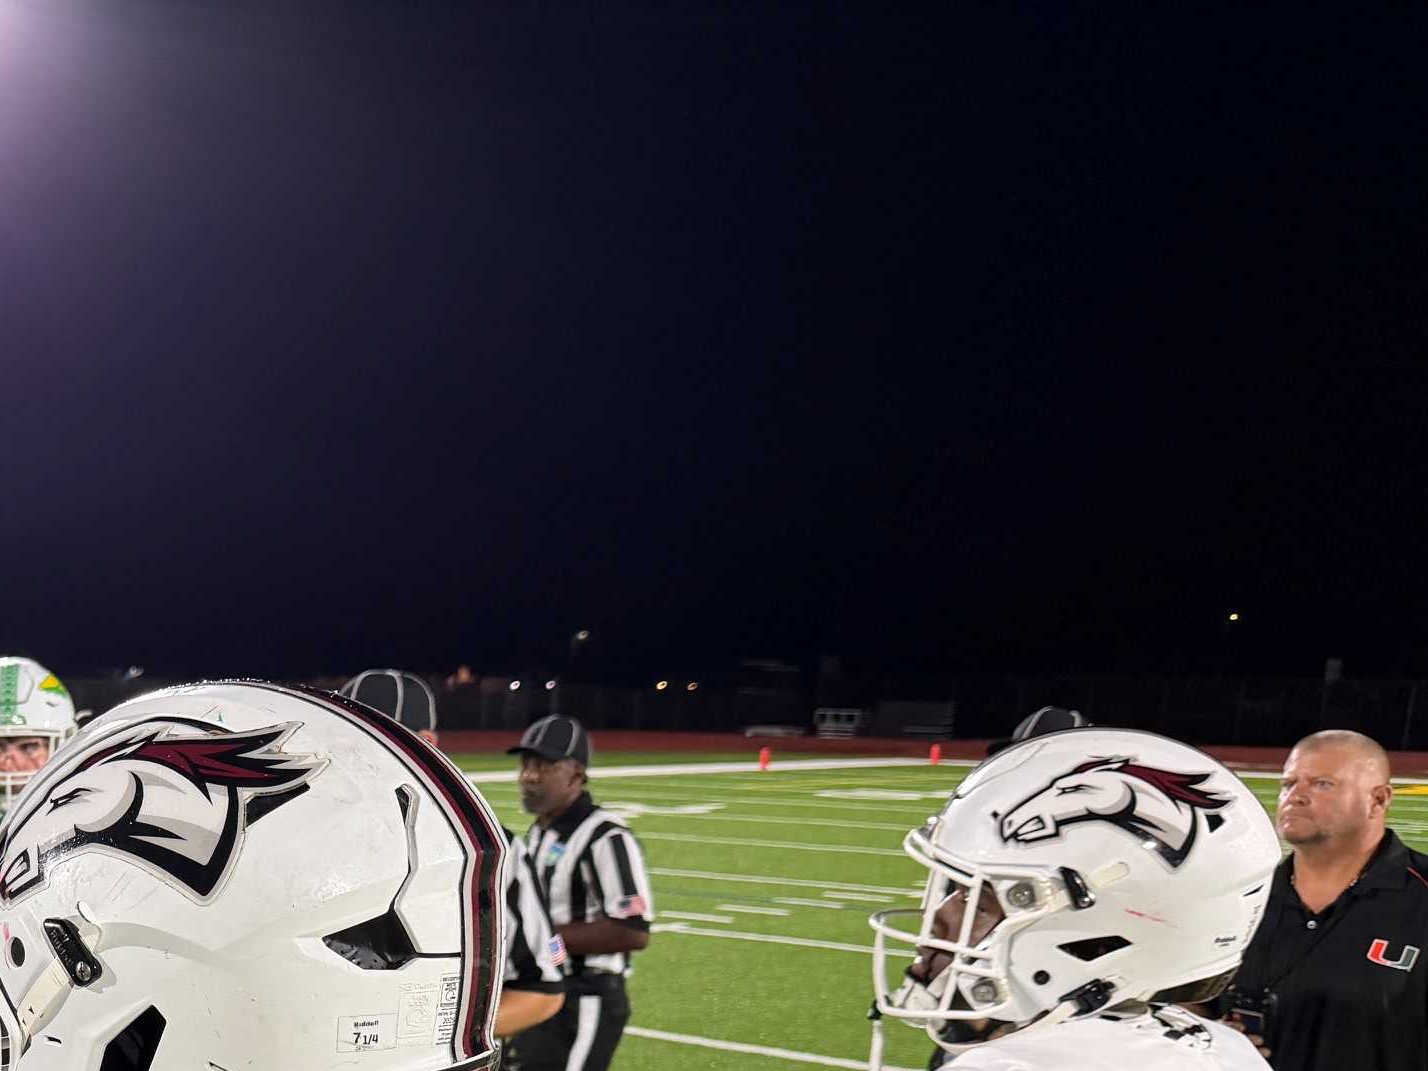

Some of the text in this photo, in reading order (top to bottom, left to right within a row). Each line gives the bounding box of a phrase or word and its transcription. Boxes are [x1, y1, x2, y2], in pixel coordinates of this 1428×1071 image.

[1366, 938, 1421, 972] U
[352, 1032, 379, 1045] 7 1/4
